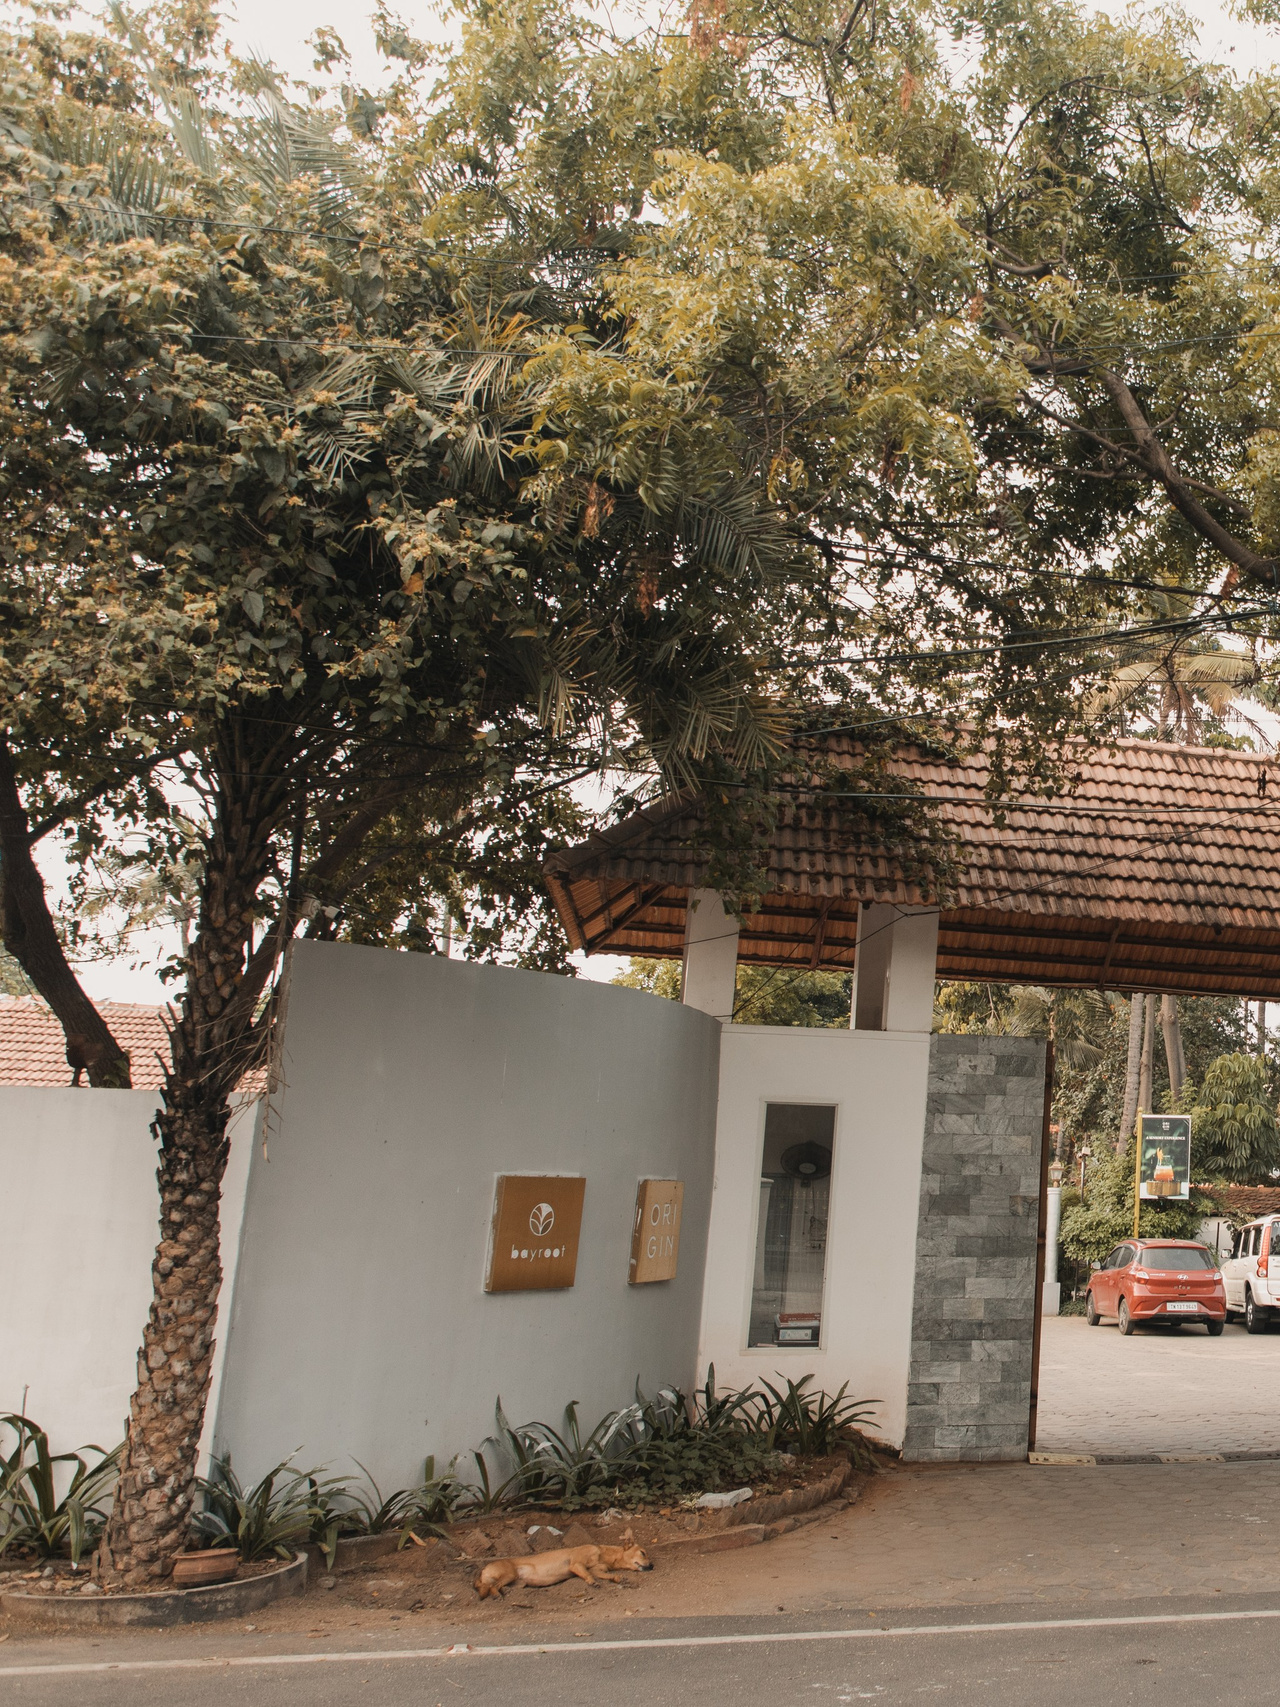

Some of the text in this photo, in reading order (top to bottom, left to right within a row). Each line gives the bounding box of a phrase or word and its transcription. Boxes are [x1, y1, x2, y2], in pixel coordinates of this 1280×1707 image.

[650, 1203, 677, 1227] ORI
[510, 1244, 566, 1262] bayroot
[646, 1235, 675, 1259] GIN
